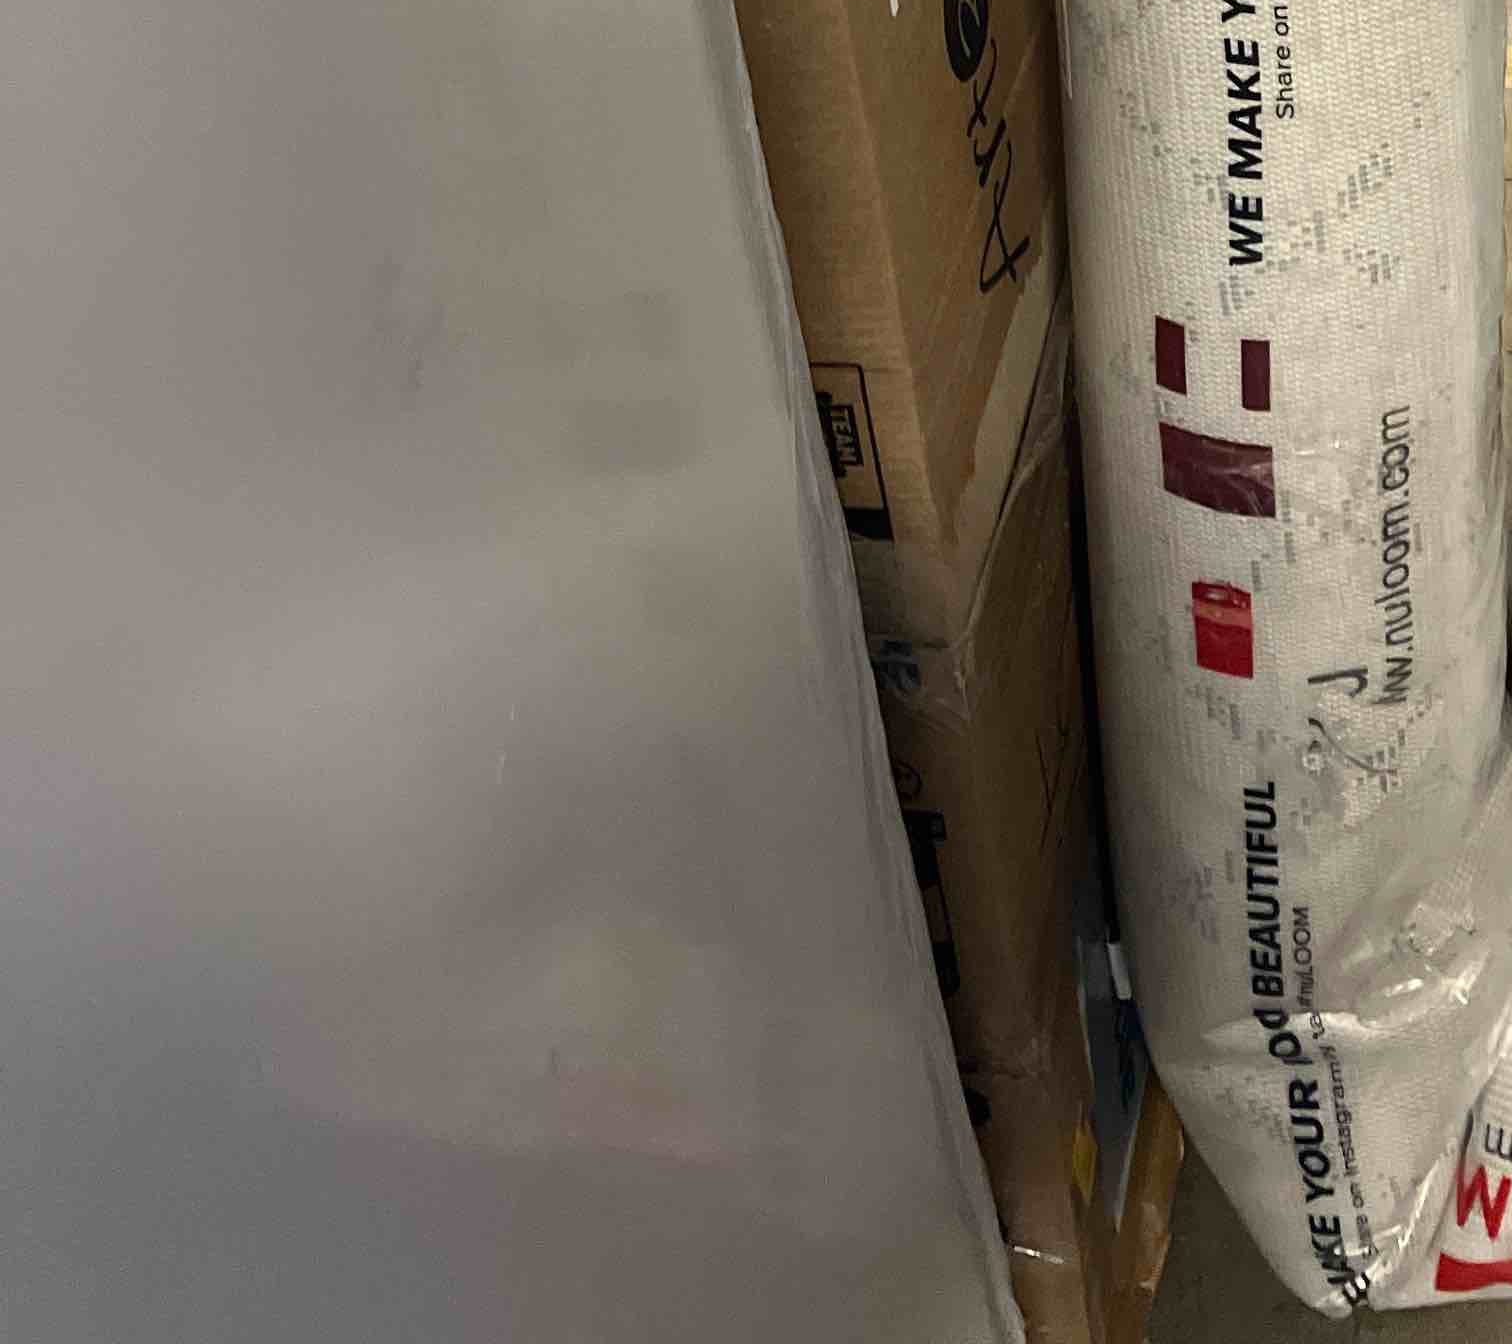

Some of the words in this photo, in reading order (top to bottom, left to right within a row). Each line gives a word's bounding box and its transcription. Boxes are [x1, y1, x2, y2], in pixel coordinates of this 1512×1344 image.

[1270, 5, 1292, 38] on
[1222, 38, 1265, 181] MAKE
[1269, 46, 1296, 120] Share
[1227, 194, 1265, 266] WE
[1243, 781, 1284, 998] BEAUTIFUL
[1288, 1079, 1335, 1203] YOUR
